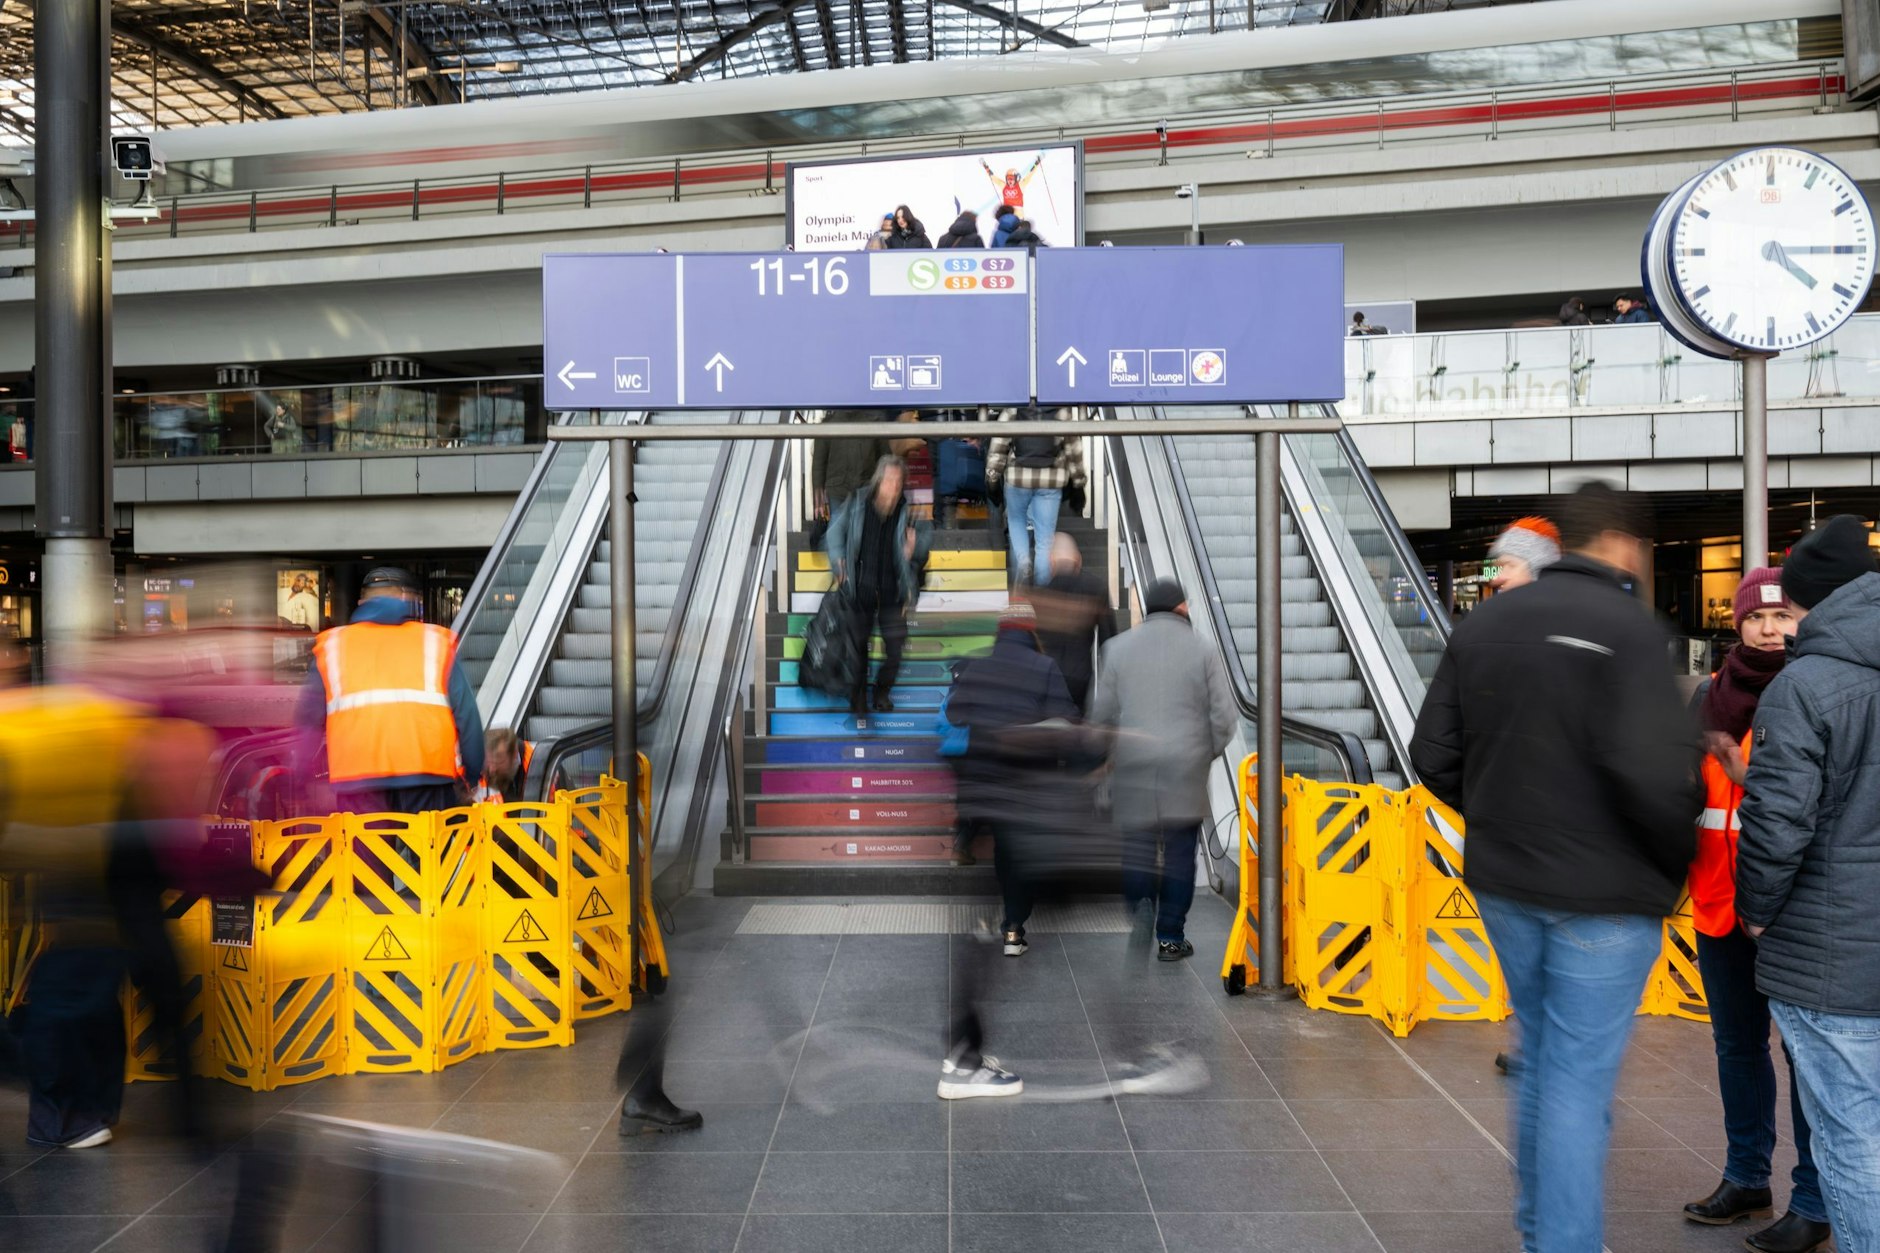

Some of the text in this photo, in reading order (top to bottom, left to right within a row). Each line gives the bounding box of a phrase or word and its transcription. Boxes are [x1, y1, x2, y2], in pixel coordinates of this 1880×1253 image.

[805, 175, 823, 183] Sport
[805, 213, 856, 228] Olympia:
[805, 230, 848, 244] Daniela
[750, 256, 849, 296] 11-16
[617, 374, 642, 389] WC
[1111, 373, 1139, 382] Polizei
[1151, 372, 1183, 384] Lounge
[876, 810, 908, 818] VOLL-NUSS
[865, 844, 912, 852] KAKAO-MOUSSE
